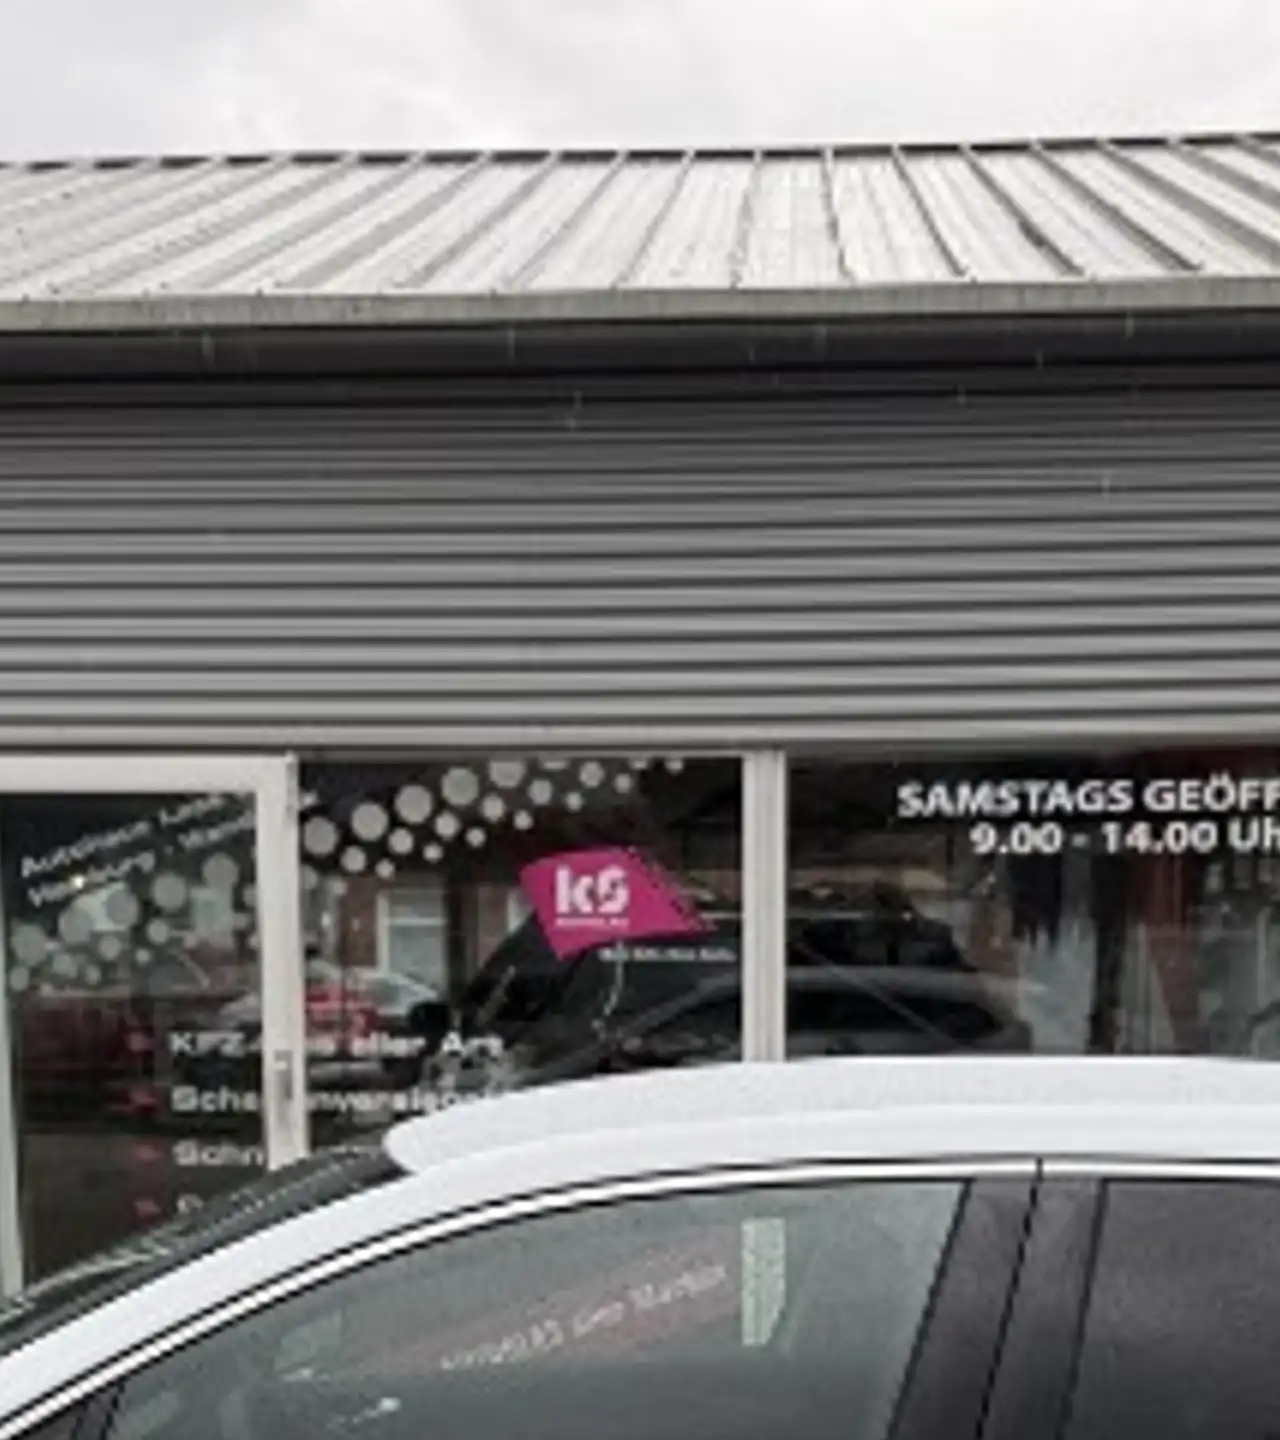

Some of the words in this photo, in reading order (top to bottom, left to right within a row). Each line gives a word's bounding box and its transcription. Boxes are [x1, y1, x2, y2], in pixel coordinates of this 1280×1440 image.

[897, 780, 1134, 816] SAMSTAGS
[969, 822, 1063, 854] 9.00
[1104, 821, 1218, 853] 14.00
